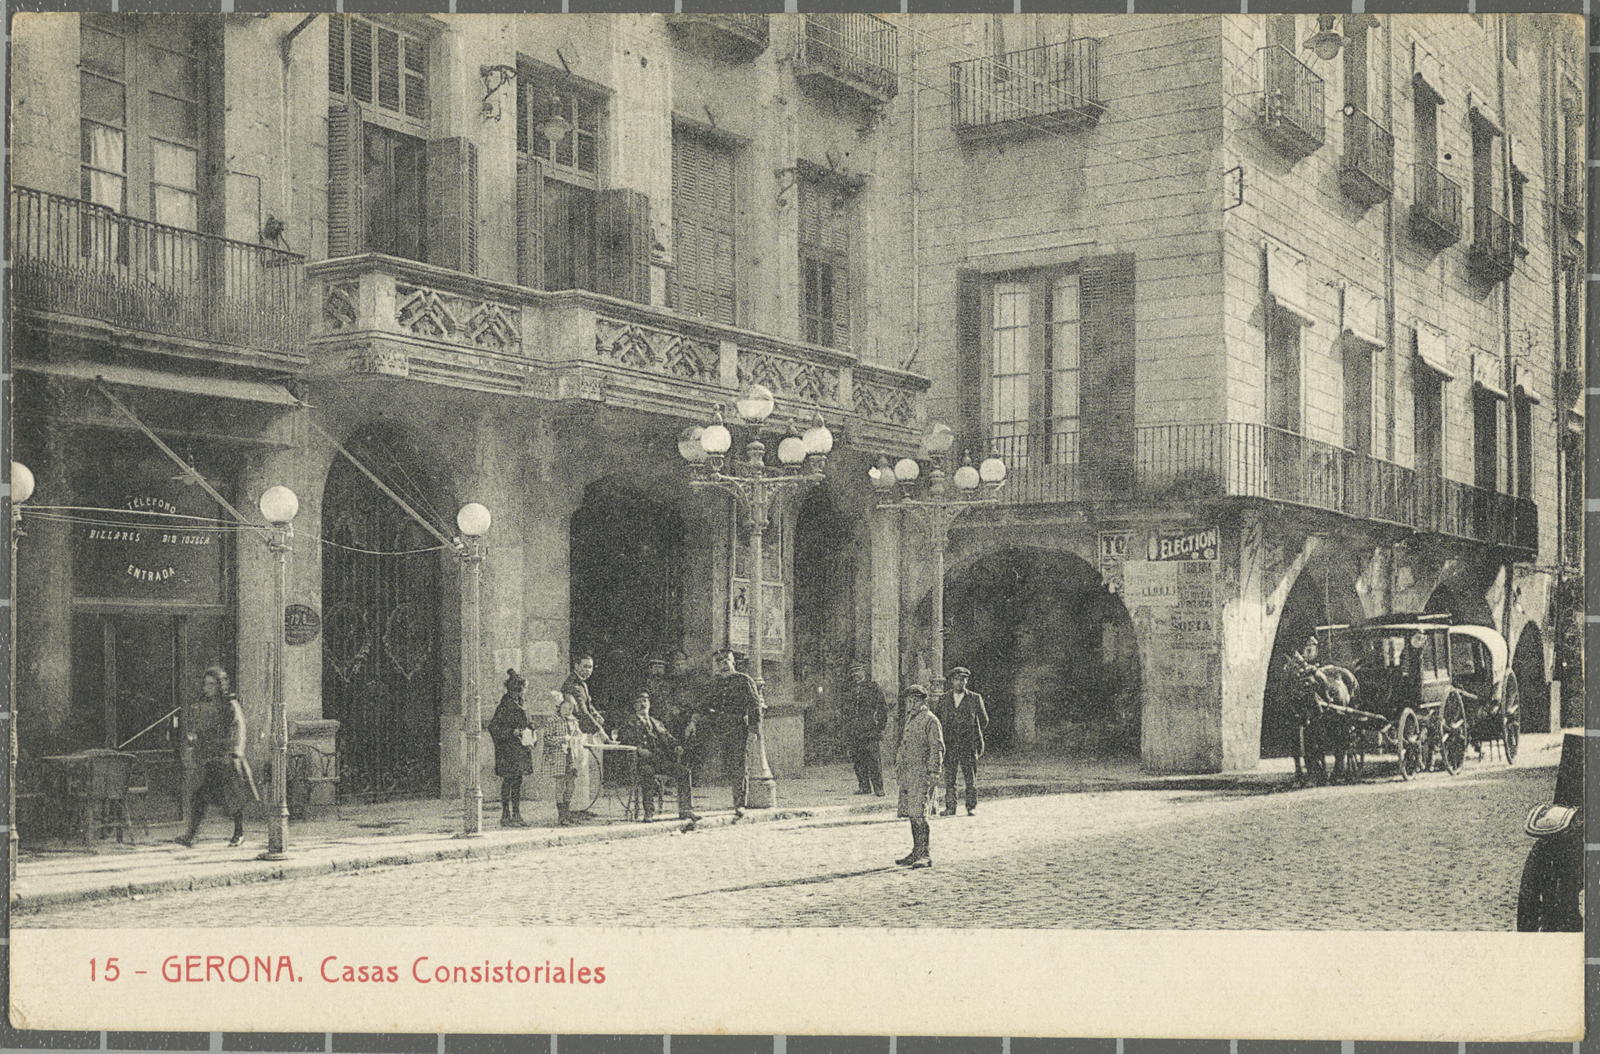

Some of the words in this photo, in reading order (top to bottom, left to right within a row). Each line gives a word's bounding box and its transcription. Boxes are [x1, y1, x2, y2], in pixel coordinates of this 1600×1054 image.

[89, 529, 141, 542] BILLARES
[1160, 529, 1217, 560] ELECTION
[127, 564, 176, 581] ENTRADA
